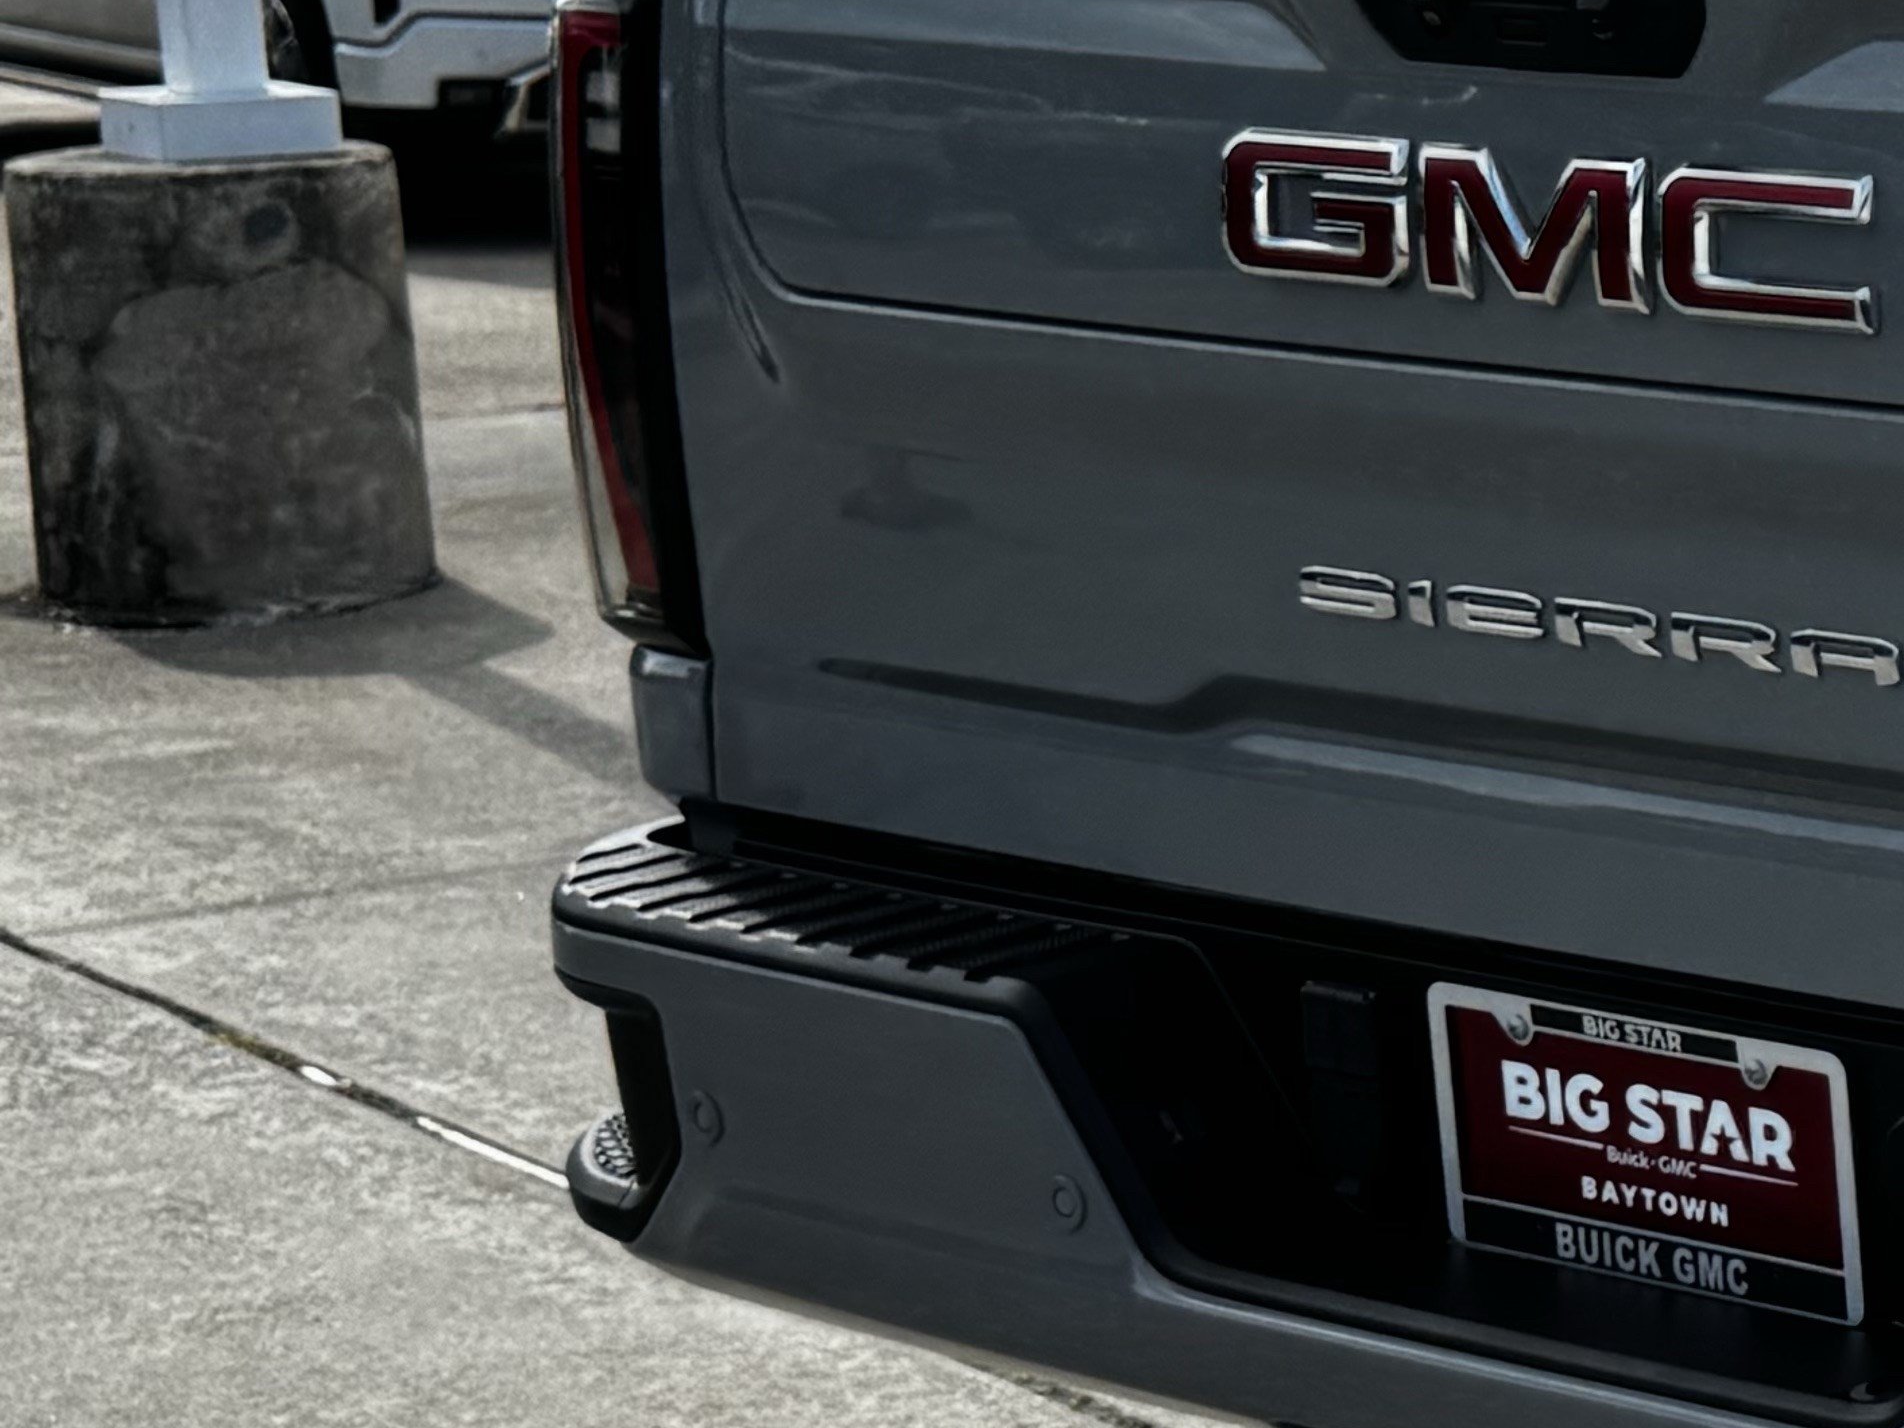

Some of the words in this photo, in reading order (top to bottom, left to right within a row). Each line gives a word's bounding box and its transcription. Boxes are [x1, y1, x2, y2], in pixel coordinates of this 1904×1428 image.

[1220, 126, 1879, 335] GMC
[1299, 565, 1904, 687] SIERRA
[1582, 1015, 1620, 1040] BIG
[1624, 1024, 1682, 1052] STAR
[1501, 1060, 1610, 1133] BIG
[1625, 1083, 1797, 1172] STAR
[1581, 1175, 1729, 1228] BAYTOWN
[1555, 1222, 1662, 1278] BUICK
[1672, 1247, 1749, 1297] GMC
